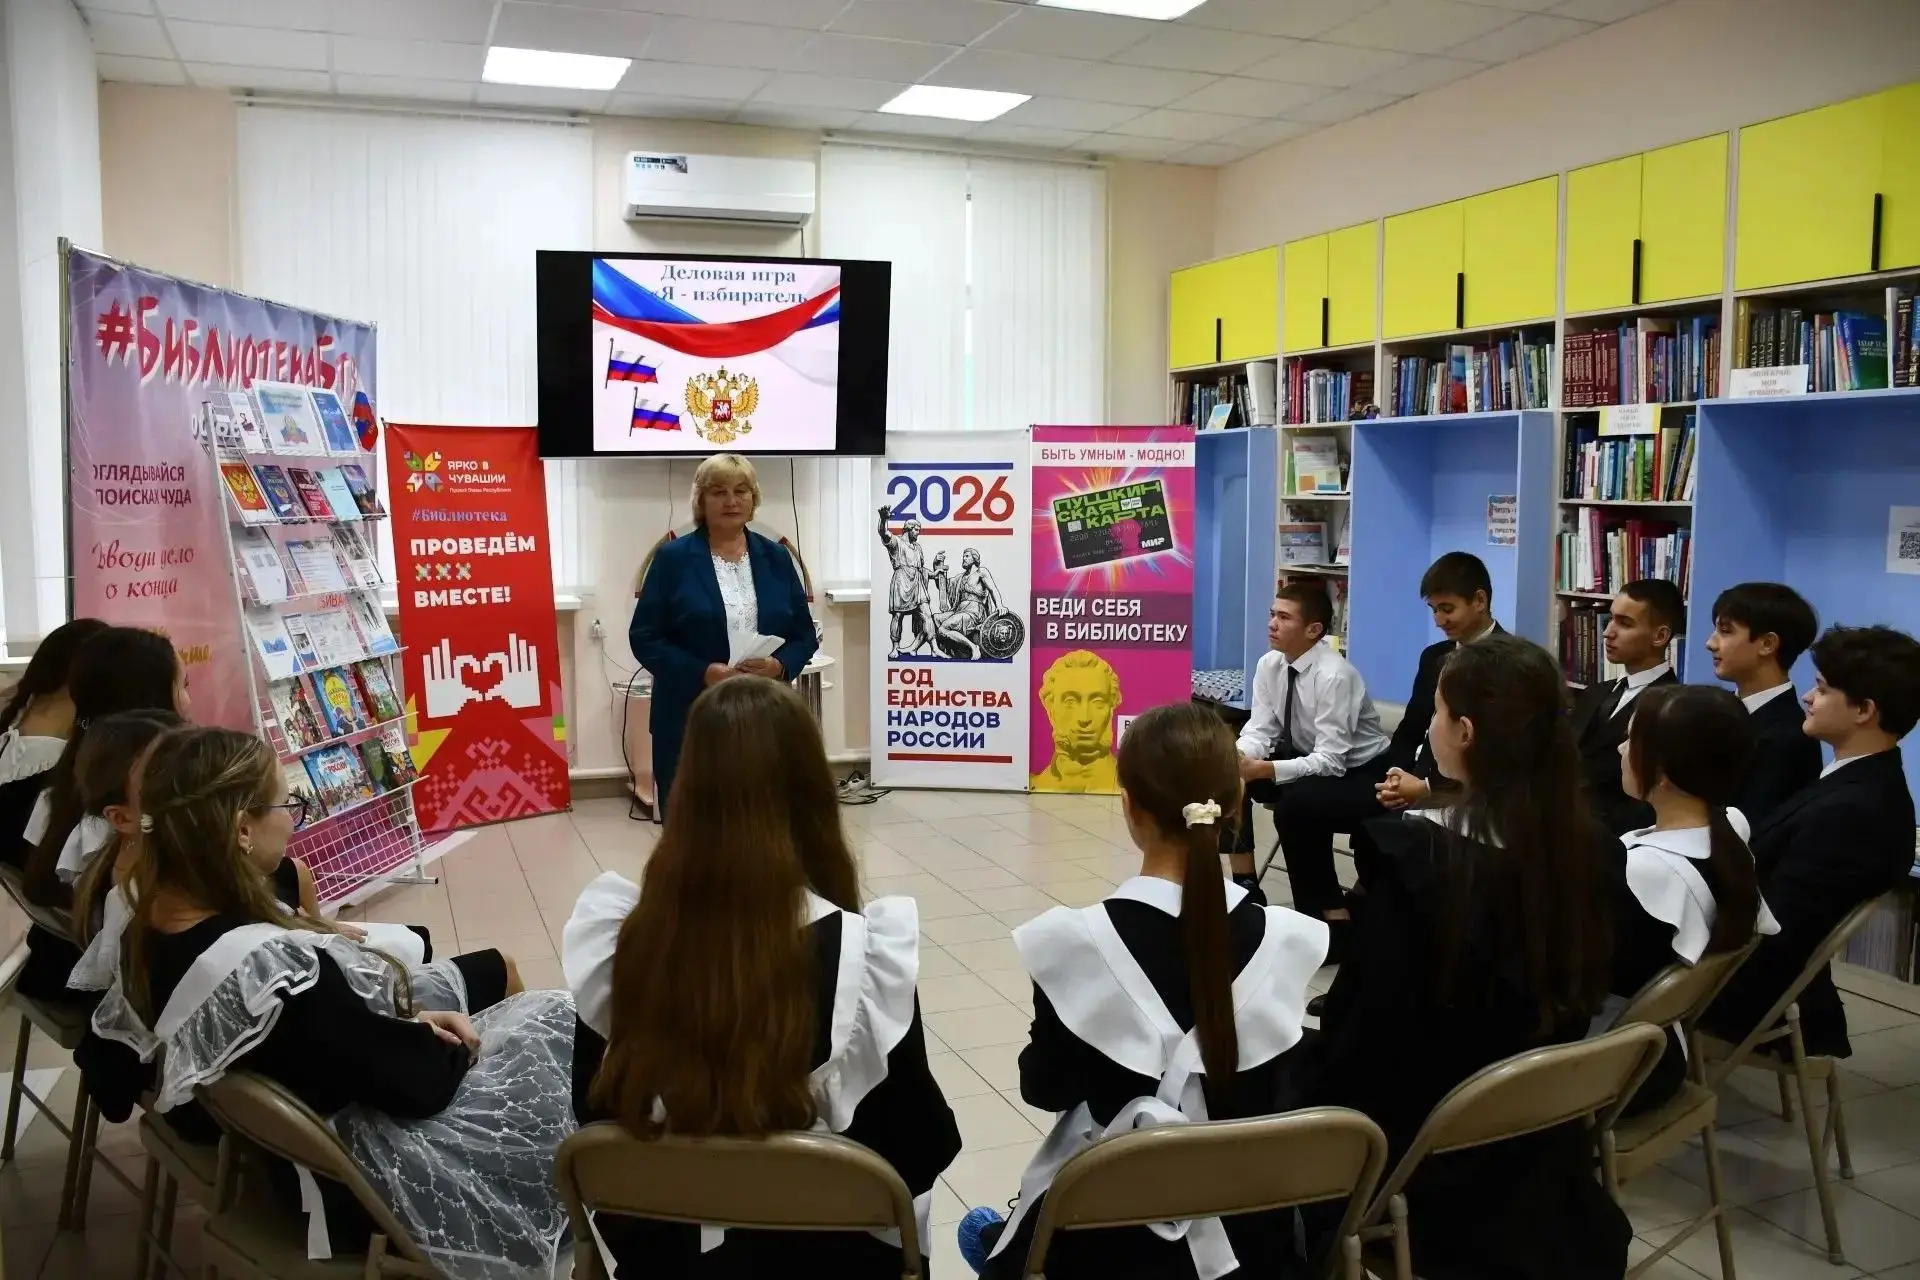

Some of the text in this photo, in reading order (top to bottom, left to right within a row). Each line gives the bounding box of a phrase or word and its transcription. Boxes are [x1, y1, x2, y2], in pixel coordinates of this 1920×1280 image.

[661, 264, 796, 286] Деловая игра
[448, 460, 489, 471] ЯРКО В
[1041, 448, 1075, 460] БЫТЬ
[1080, 448, 1126, 461] УМНЫМ
[1137, 449, 1185, 463] МОДНО!
[448, 474, 506, 484] ЧУВАШИИ
[161, 488, 192, 508] ЧУДА
[887, 475, 1015, 522] 2026
[412, 507, 508, 523] #Библиотека
[1085, 504, 1164, 529] КАРТА
[411, 531, 536, 556] ПРОВЕДЁМ
[1141, 537, 1165, 549] МИР
[127, 578, 178, 599] конца
[414, 586, 511, 608] ВМЕСТЕ!
[1036, 597, 1141, 618] ВЕДИ СЕБЯ
[1046, 622, 1188, 642] В БИБЛИОТЕКУ
[888, 669, 933, 687] ГОД
[888, 690, 1013, 708] ЕДИНСТВА
[888, 710, 1001, 730] НАРОДОВ
[888, 731, 985, 749] РОССИИ
